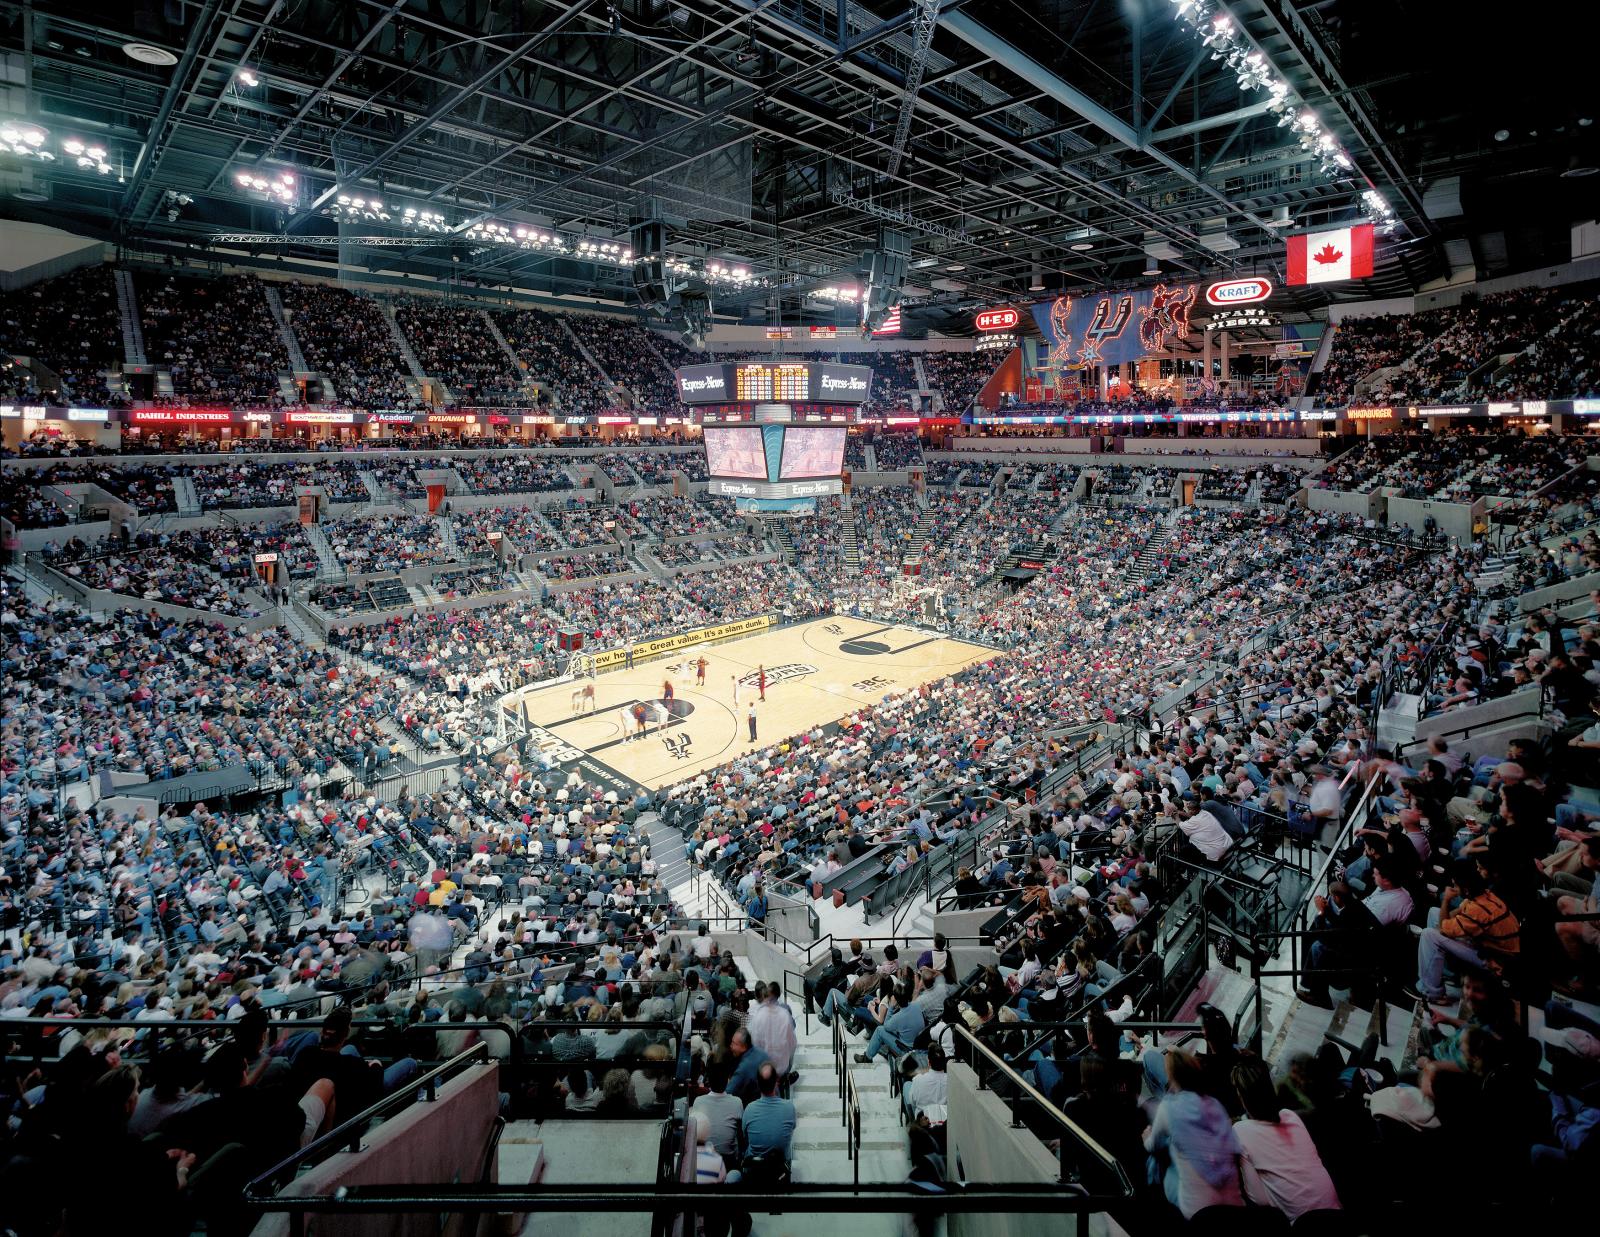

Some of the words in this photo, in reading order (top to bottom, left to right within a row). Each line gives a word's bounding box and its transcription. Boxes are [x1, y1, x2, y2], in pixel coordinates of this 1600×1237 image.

[1219, 285, 1258, 298] KRAFT
[1220, 309, 1257, 319] FAN
[1206, 318, 1272, 331] FIESTA
[986, 334, 1010, 342] FAN
[976, 342, 1018, 351] FIESTA
[681, 376, 725, 392] Express-News
[821, 375, 867, 391] Express-News
[136, 412, 174, 420] DAHILL
[243, 412, 272, 422] Jeep
[379, 414, 415, 423] Academy
[1182, 413, 1221, 421] Warriors
[1227, 413, 1240, 421] 58
[1347, 408, 1393, 418] WHATABURGER
[721, 483, 757, 495] Express-News
[792, 482, 830, 496] Express-News
[614, 648, 648, 660] hoes.
[650, 640, 675, 651] Great
[677, 634, 702, 646] value.
[704, 628, 716, 638] It's
[725, 624, 743, 634] slam
[745, 619, 765, 629] dunk.
[851, 675, 887, 690] SBC
